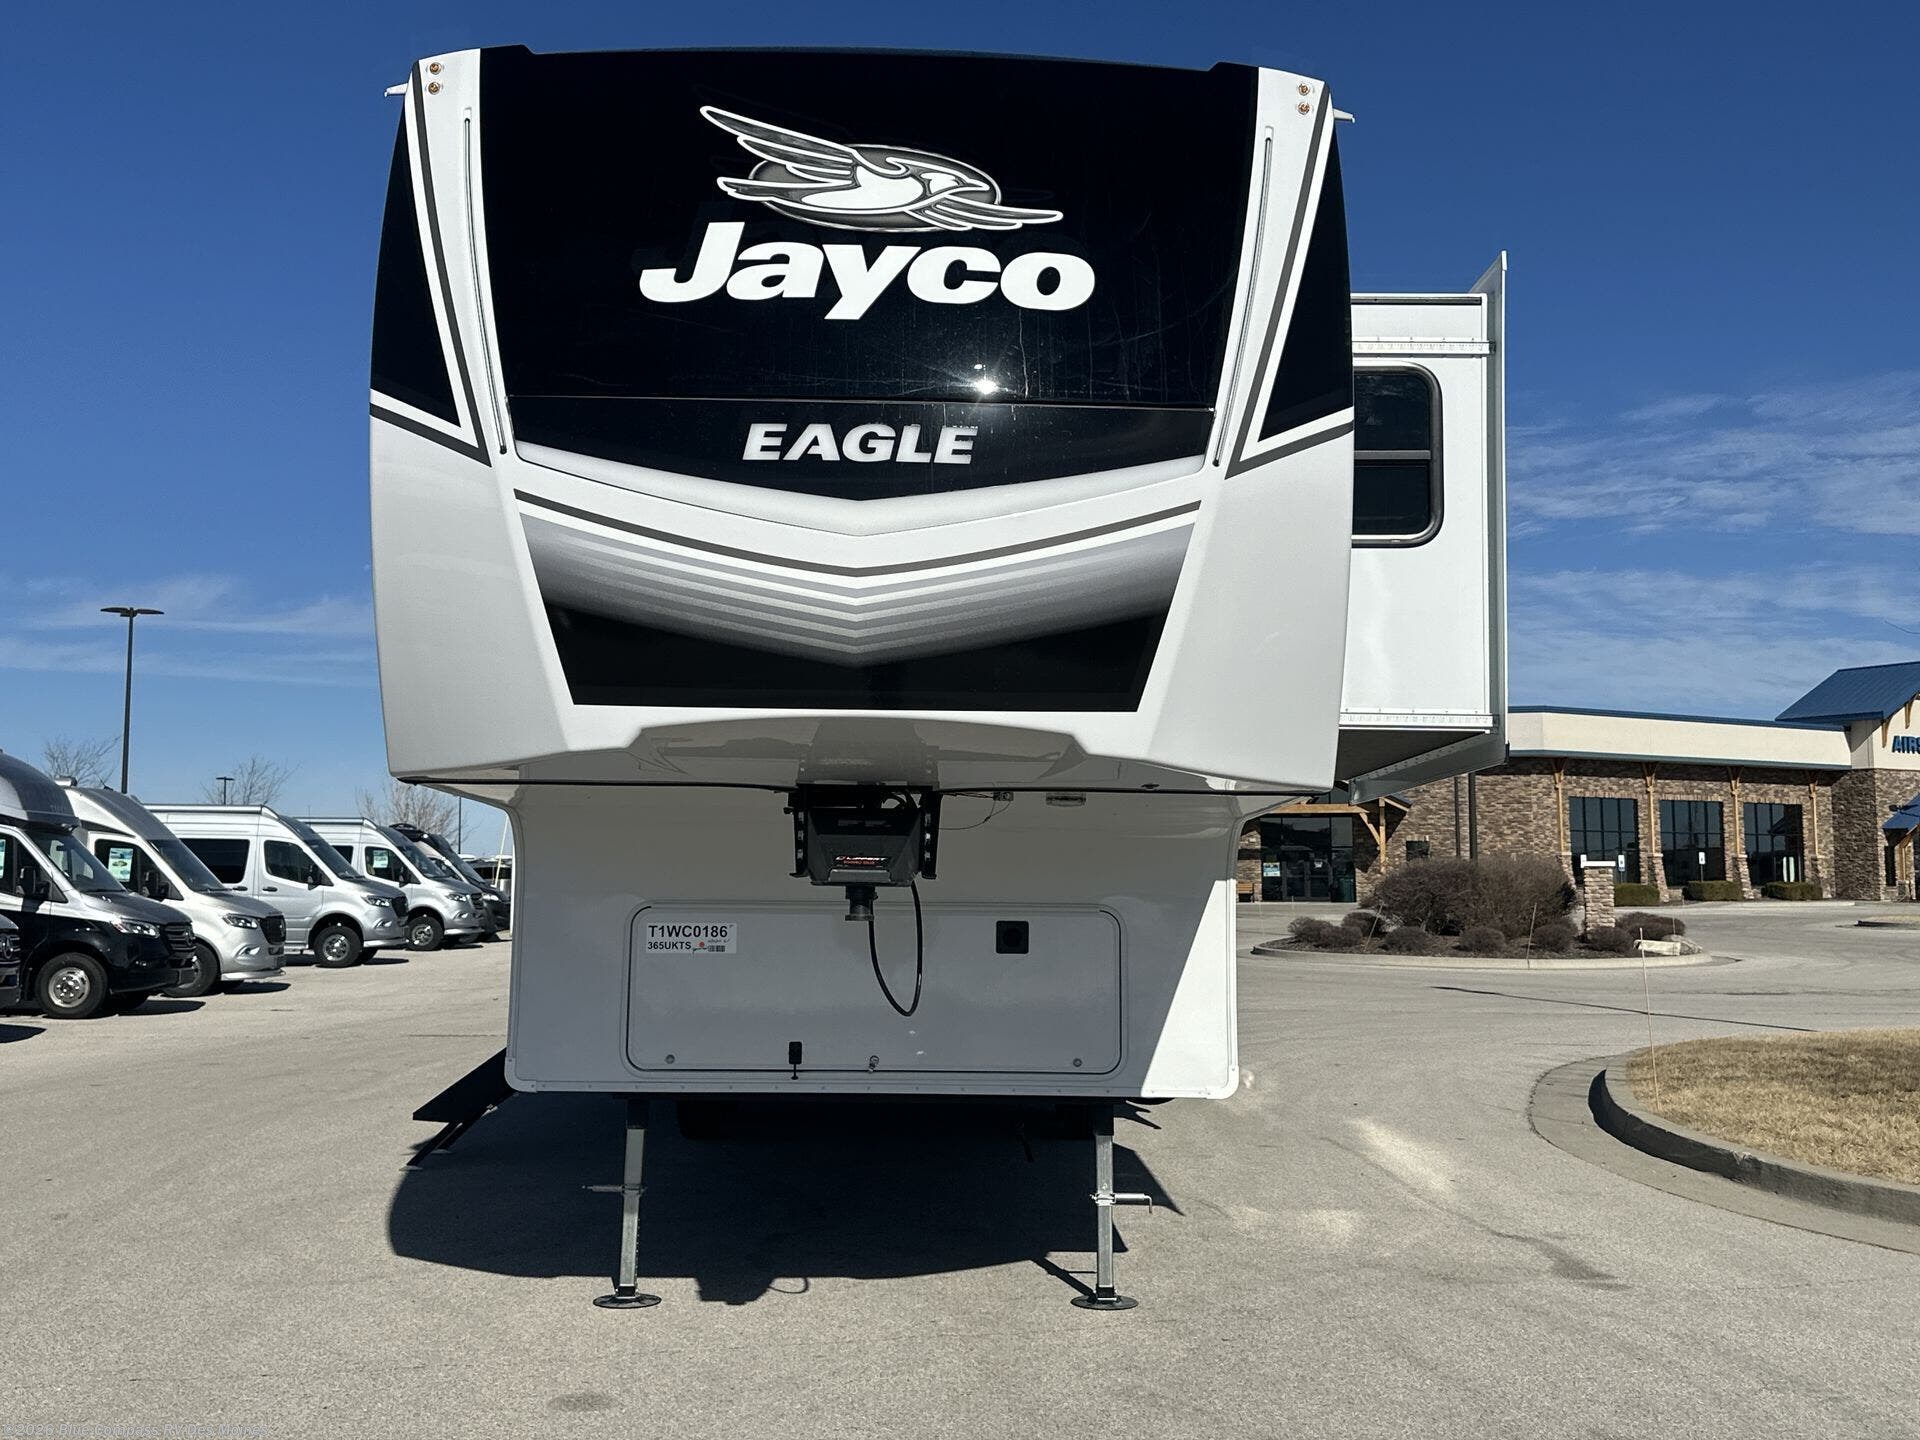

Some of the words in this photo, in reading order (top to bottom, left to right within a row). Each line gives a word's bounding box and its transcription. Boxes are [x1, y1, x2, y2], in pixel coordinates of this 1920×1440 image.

[639, 221, 1096, 320] Jayco
[742, 423, 978, 465] EAGLE
[648, 925, 728, 938] T1WC0186
[647, 941, 692, 950] 365UKTS
